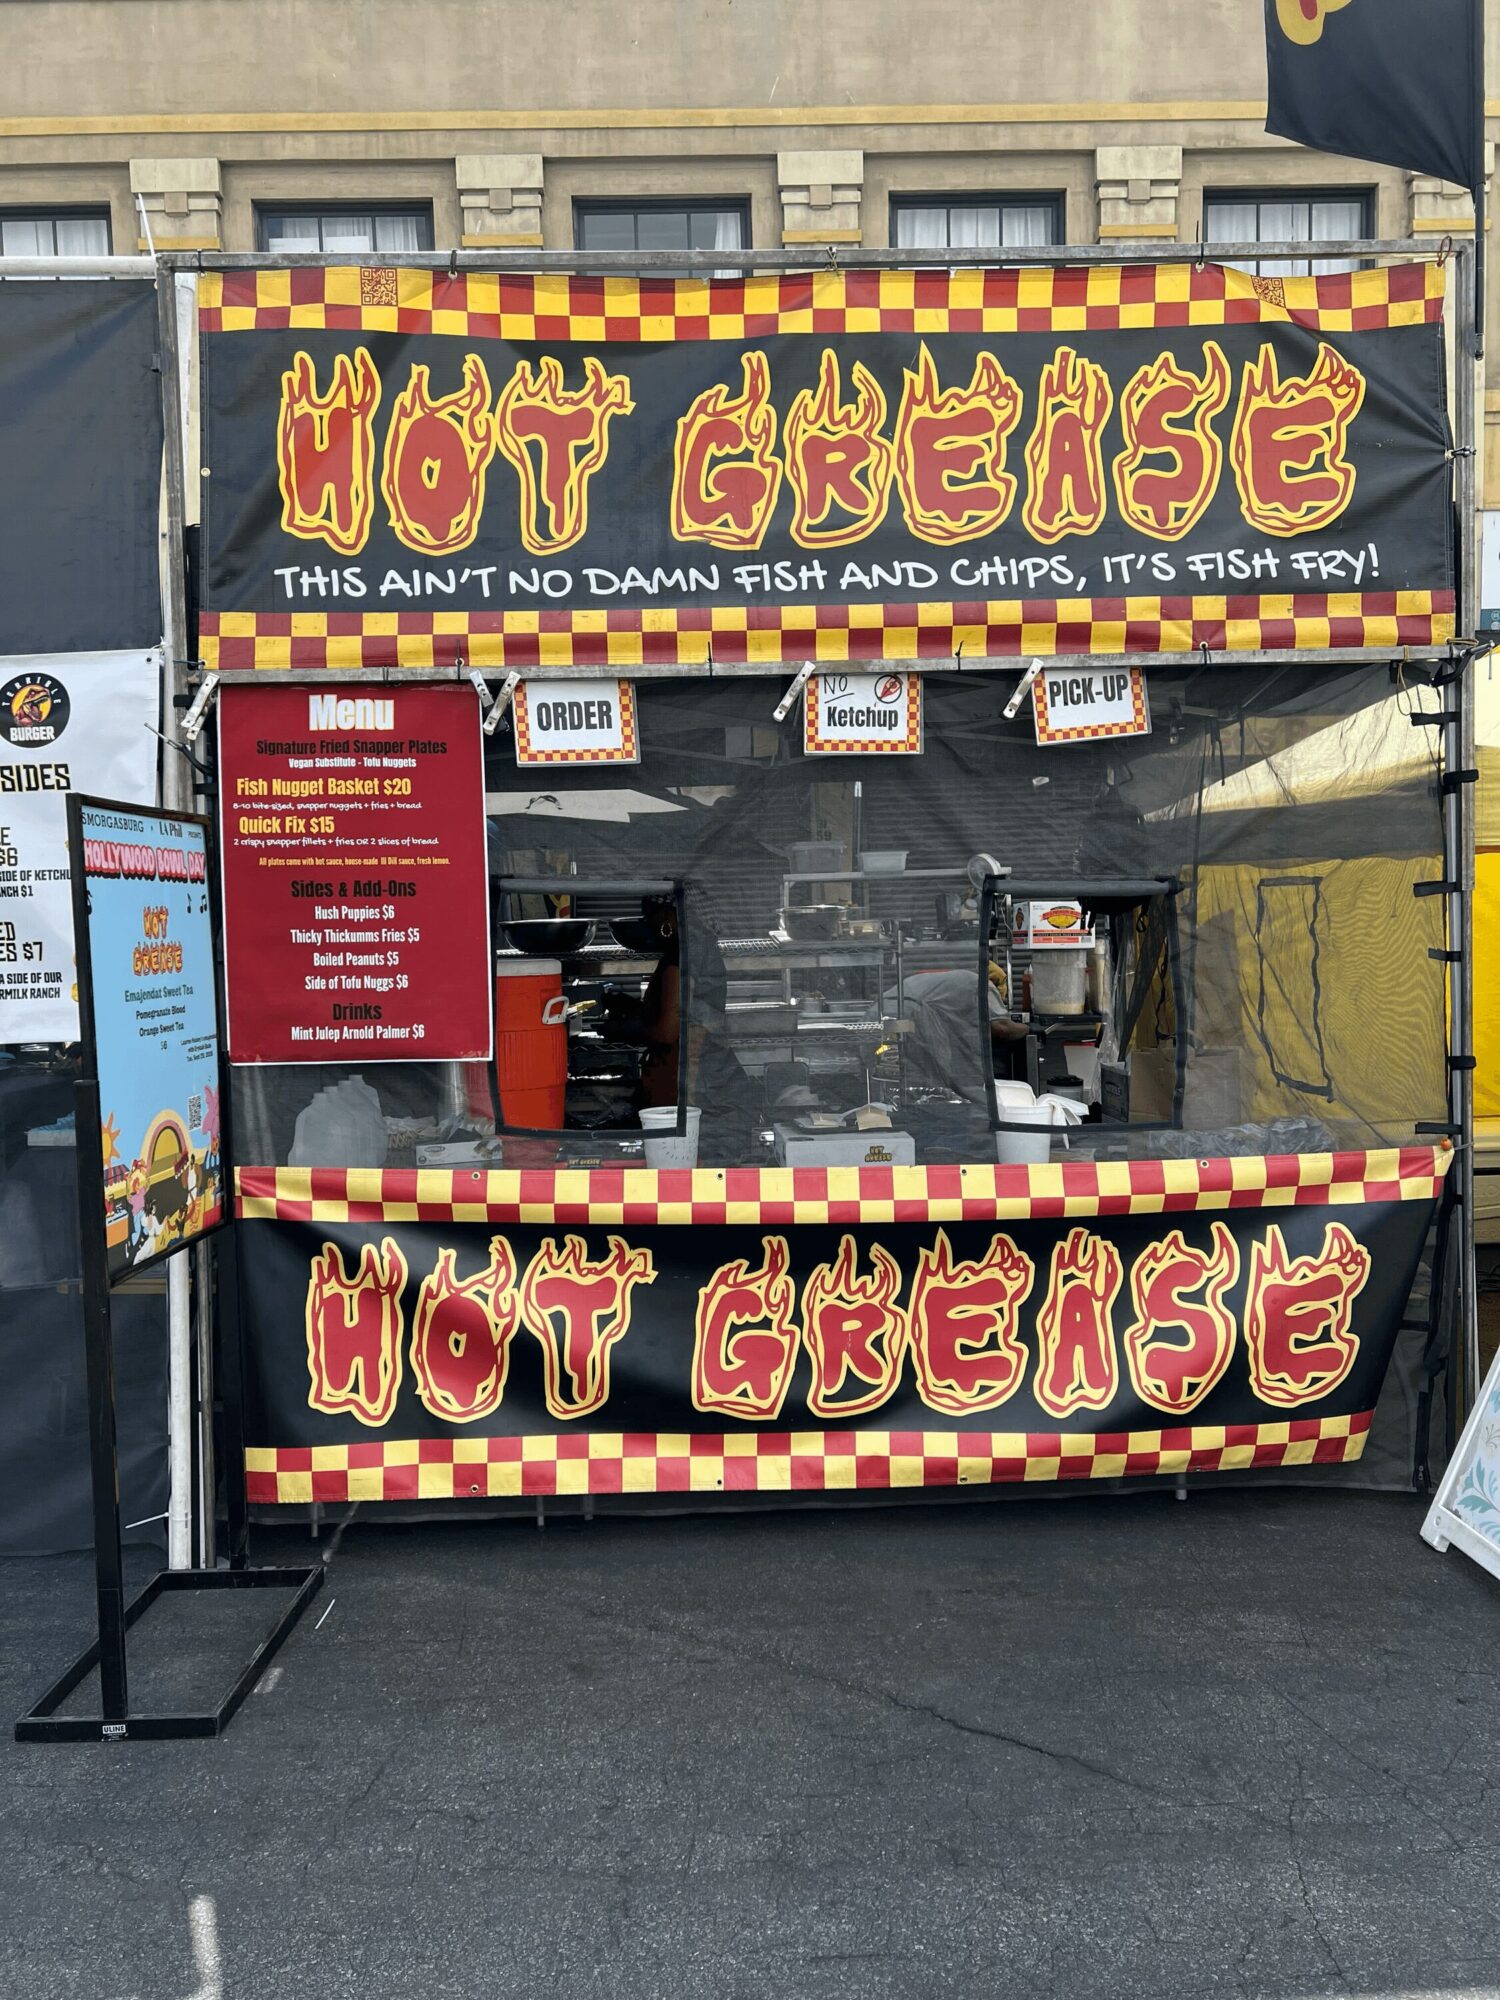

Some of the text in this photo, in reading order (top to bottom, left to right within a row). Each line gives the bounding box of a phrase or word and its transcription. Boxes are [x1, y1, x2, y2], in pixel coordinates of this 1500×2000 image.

[277, 340, 1366, 556] HOT GREASE
[274, 543, 1380, 599] THIS AIN'T NO DAMN FISH AND CHIPS, IT'S FISH FRY!
[1, 676, 62, 707] TERRIBLE
[823, 675, 848, 695] NO
[1048, 674, 1129, 708] PICK-UP
[309, 694, 395, 731] Menu
[536, 700, 613, 731] ORDER
[827, 706, 899, 731] Ketchup
[9, 726, 56, 742] BURGER
[256, 739, 448, 756] Signature Fried Snapper Plates
[288, 758, 314, 769] Vegan
[315, 757, 356, 768] Substitute
[363, 757, 381, 768] Tofu
[382, 757, 417, 769] Nuggets
[0, 763, 71, 792] SIDES
[236, 777, 412, 798] Fish Nugget Basket $20
[296, 803, 327, 812] snapper
[328, 802, 363, 812] nuggets
[370, 801, 389, 811] fries
[80, 812, 144, 833] SMORGASBURG
[239, 815, 335, 835] Quick Fix $15
[233, 838, 240, 846] 2
[240, 837, 265, 849] crispy
[266, 838, 301, 849] snapper
[302, 836, 327, 848] fillets
[335, 836, 355, 848] fries
[355, 838, 369, 847] OR
[370, 838, 377, 846] 2
[377, 836, 400, 847] slices
[400, 836, 411, 848] of
[83, 839, 206, 885] HOLLYWOOD BOWL DAY
[268, 857, 285, 867] plates
[302, 857, 315, 866] with
[315, 857, 325, 866] hot
[416, 857, 432, 865] fresh
[0, 870, 17, 882] IDE
[20, 870, 32, 882] OF
[20, 885, 33, 898] $1
[291, 880, 417, 898] Sides & Add-Ons
[142, 905, 169, 940] HOT
[314, 904, 395, 922] Hush Puppies $6
[290, 927, 420, 946] Thicky Thickumms Fries $5
[22, 941, 43, 962] $7
[132, 940, 184, 977] GREASE
[313, 951, 400, 967] Boiled Peanuts $5
[6, 972, 29, 985] SIDE
[30, 971, 42, 984] OF
[43, 971, 63, 984] OUR
[305, 974, 409, 992] Side of Tofu Nuggs $6
[29, 987, 61, 1000] RANCH
[162, 985, 182, 999] Sweet
[182, 984, 194, 996] Tea
[332, 1003, 383, 1020] Drinks
[159, 1022, 175, 1034] Sweet
[175, 1021, 185, 1031] Tea
[291, 1023, 425, 1043] Mint Julep Arnold Palmer $6
[305, 1222, 1371, 1427] HOT GREASE
[103, 1725, 126, 1733] ULINE
